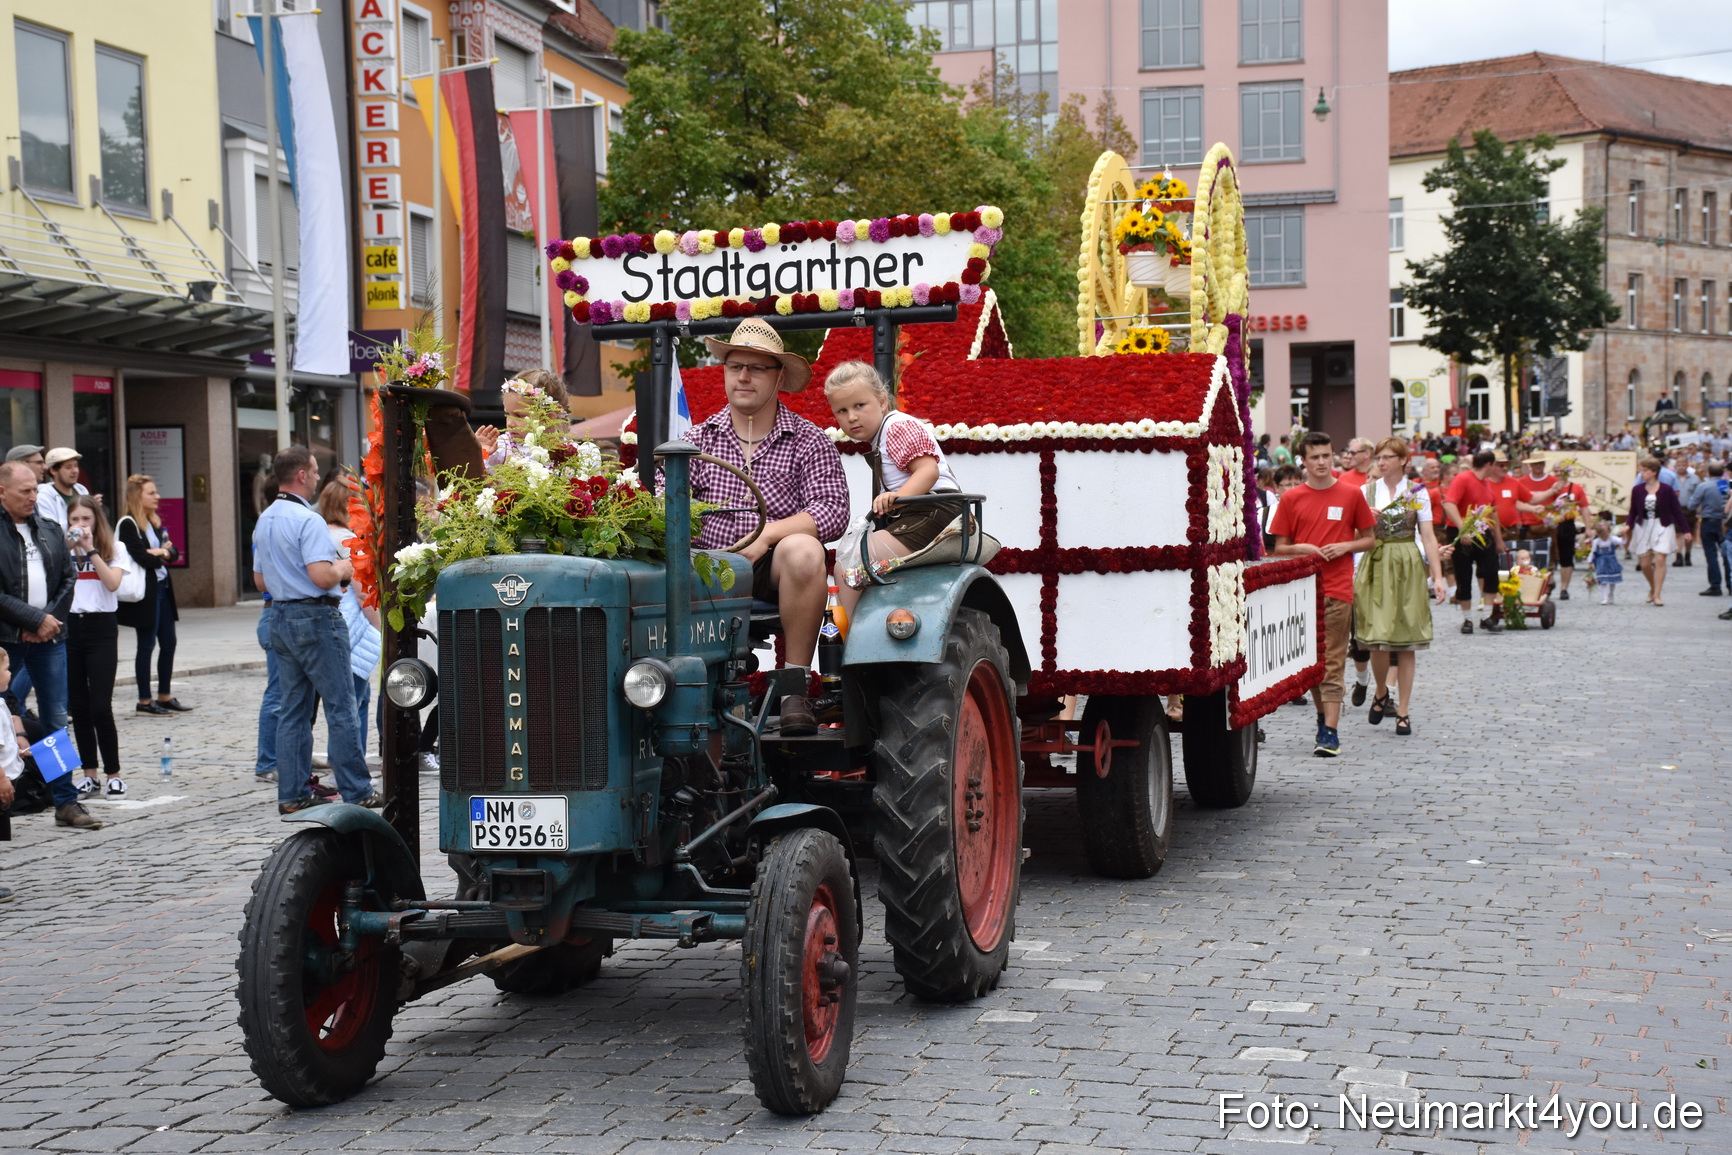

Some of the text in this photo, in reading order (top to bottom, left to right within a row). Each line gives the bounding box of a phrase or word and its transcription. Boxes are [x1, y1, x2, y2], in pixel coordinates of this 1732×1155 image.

[360, 0, 389, 235] ACKEREI
[366, 249, 397, 268] café
[621, 242, 924, 303] Stadtgärtner
[367, 286, 399, 304] plank
[140, 431, 168, 440] ADLER
[1260, 604, 1278, 675] han
[1279, 620, 1285, 667] a
[1286, 589, 1307, 662] dabei
[506, 618, 524, 781] HANOMAG
[487, 801, 515, 823] NM
[550, 824, 563, 834] 04
[551, 838, 564, 848] 10
